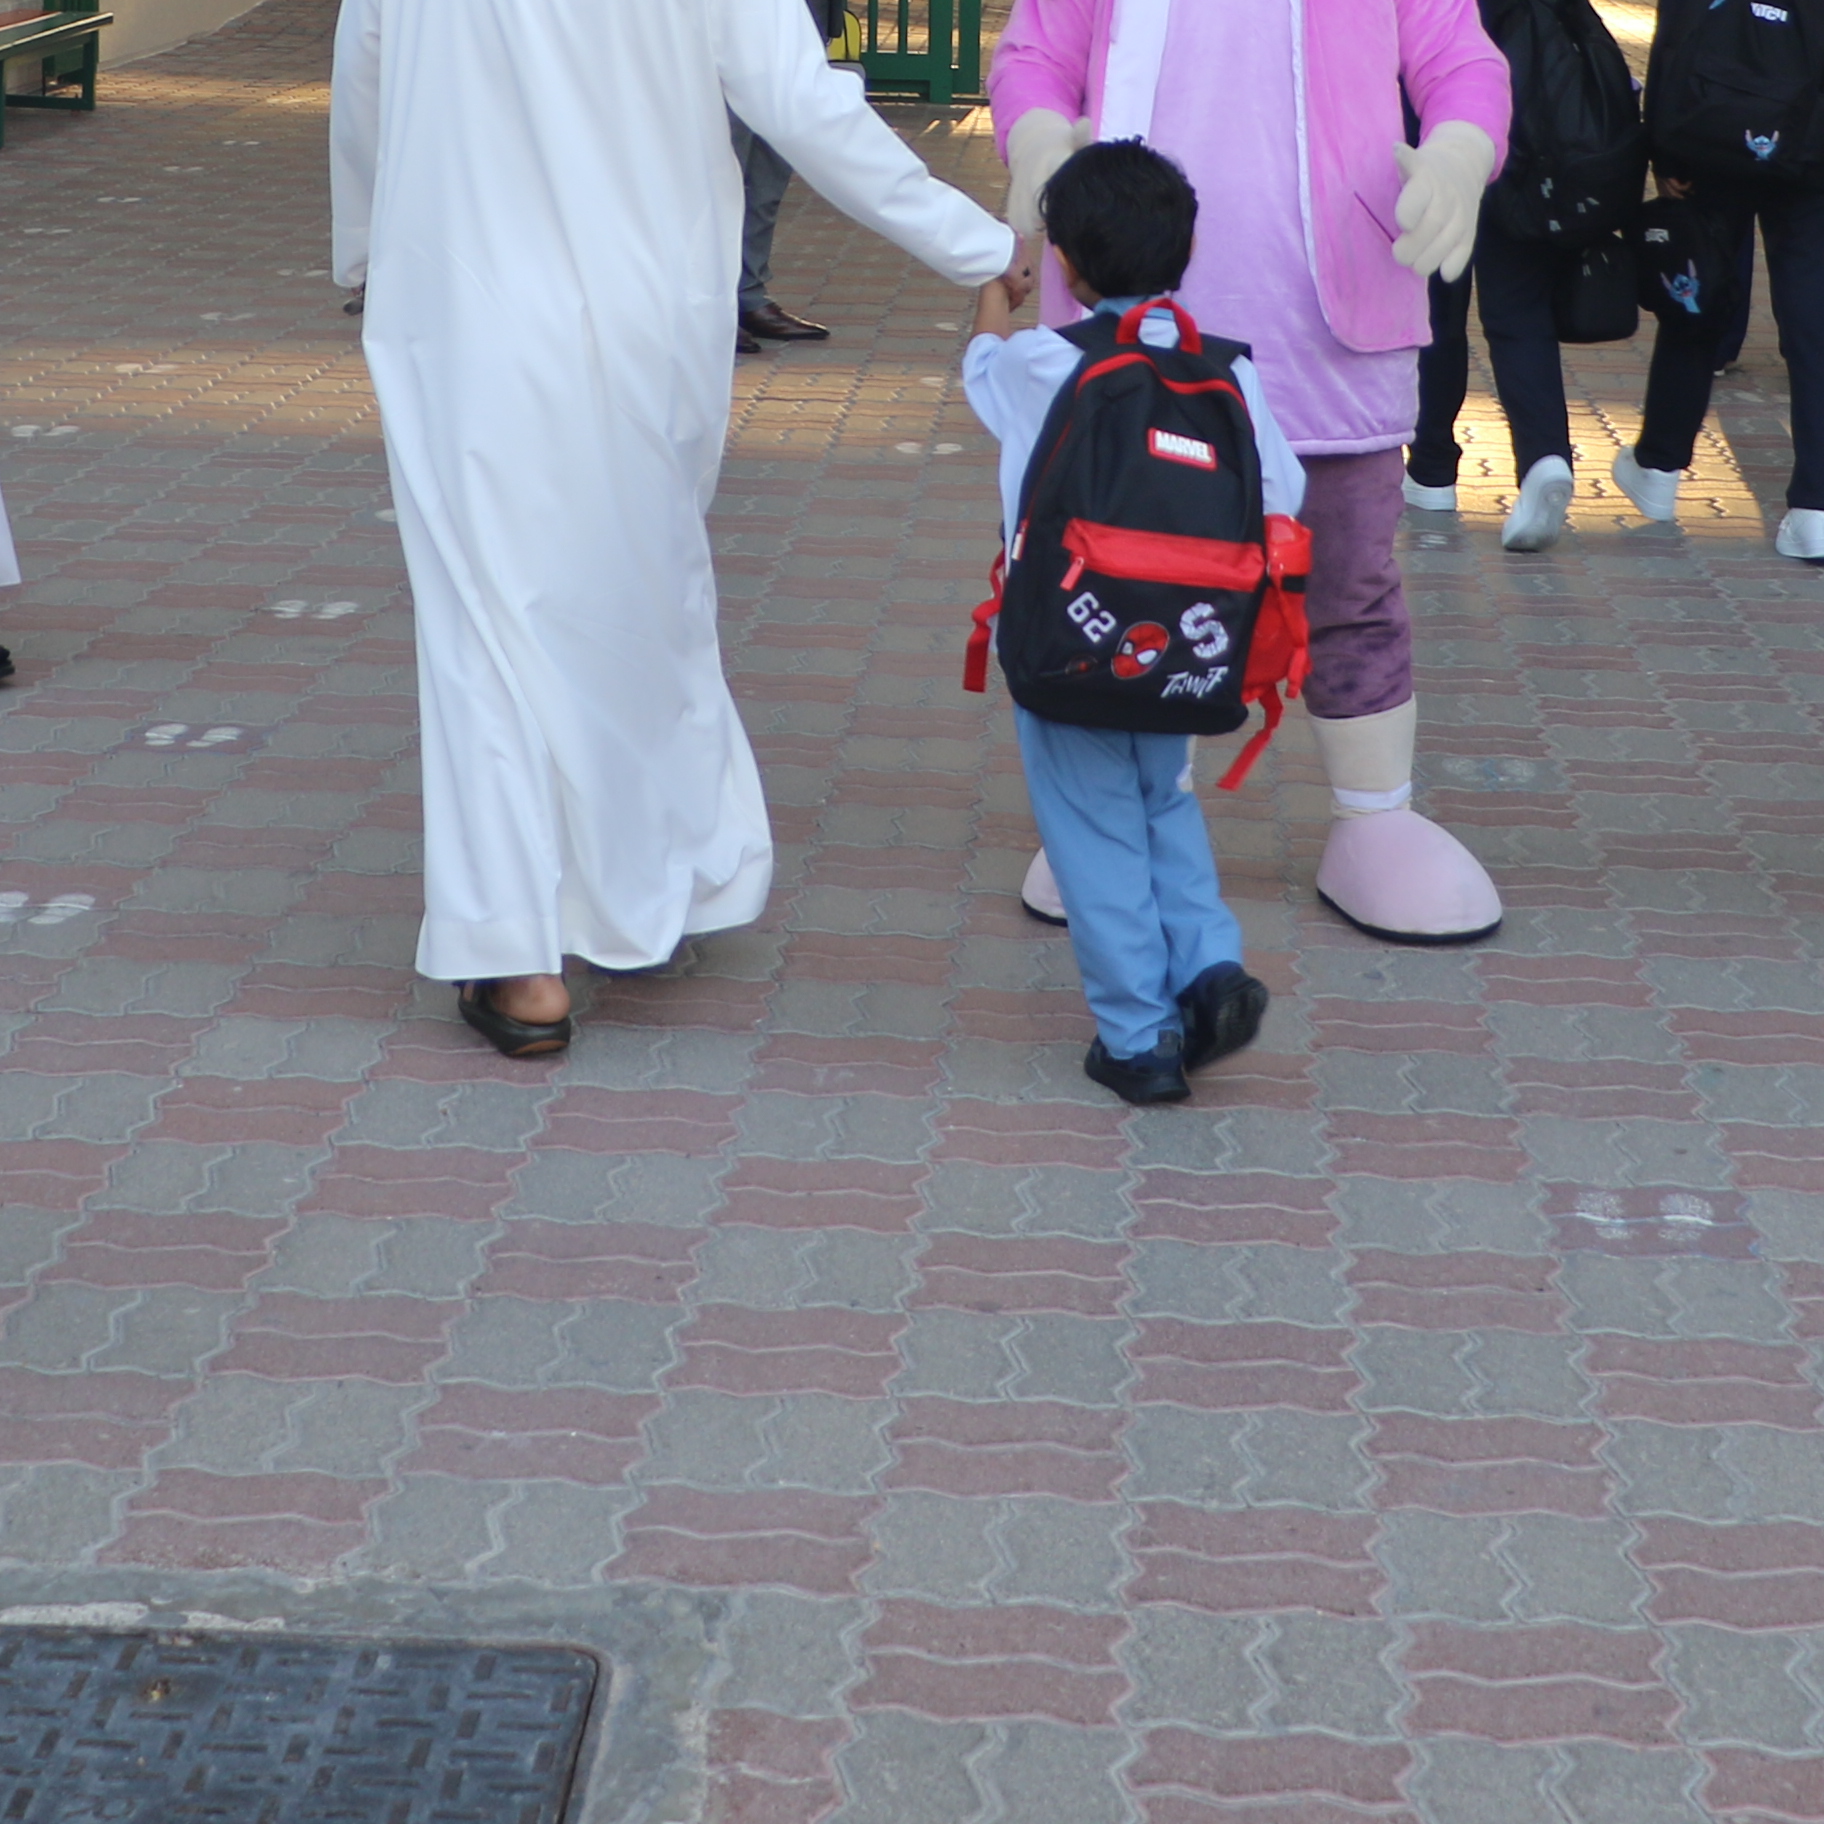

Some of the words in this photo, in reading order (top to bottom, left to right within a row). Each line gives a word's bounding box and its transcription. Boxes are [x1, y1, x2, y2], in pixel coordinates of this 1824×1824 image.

[1154, 429, 1213, 464] MARVEL
[1066, 591, 1117, 644] 62
[1179, 601, 1230, 659] S
